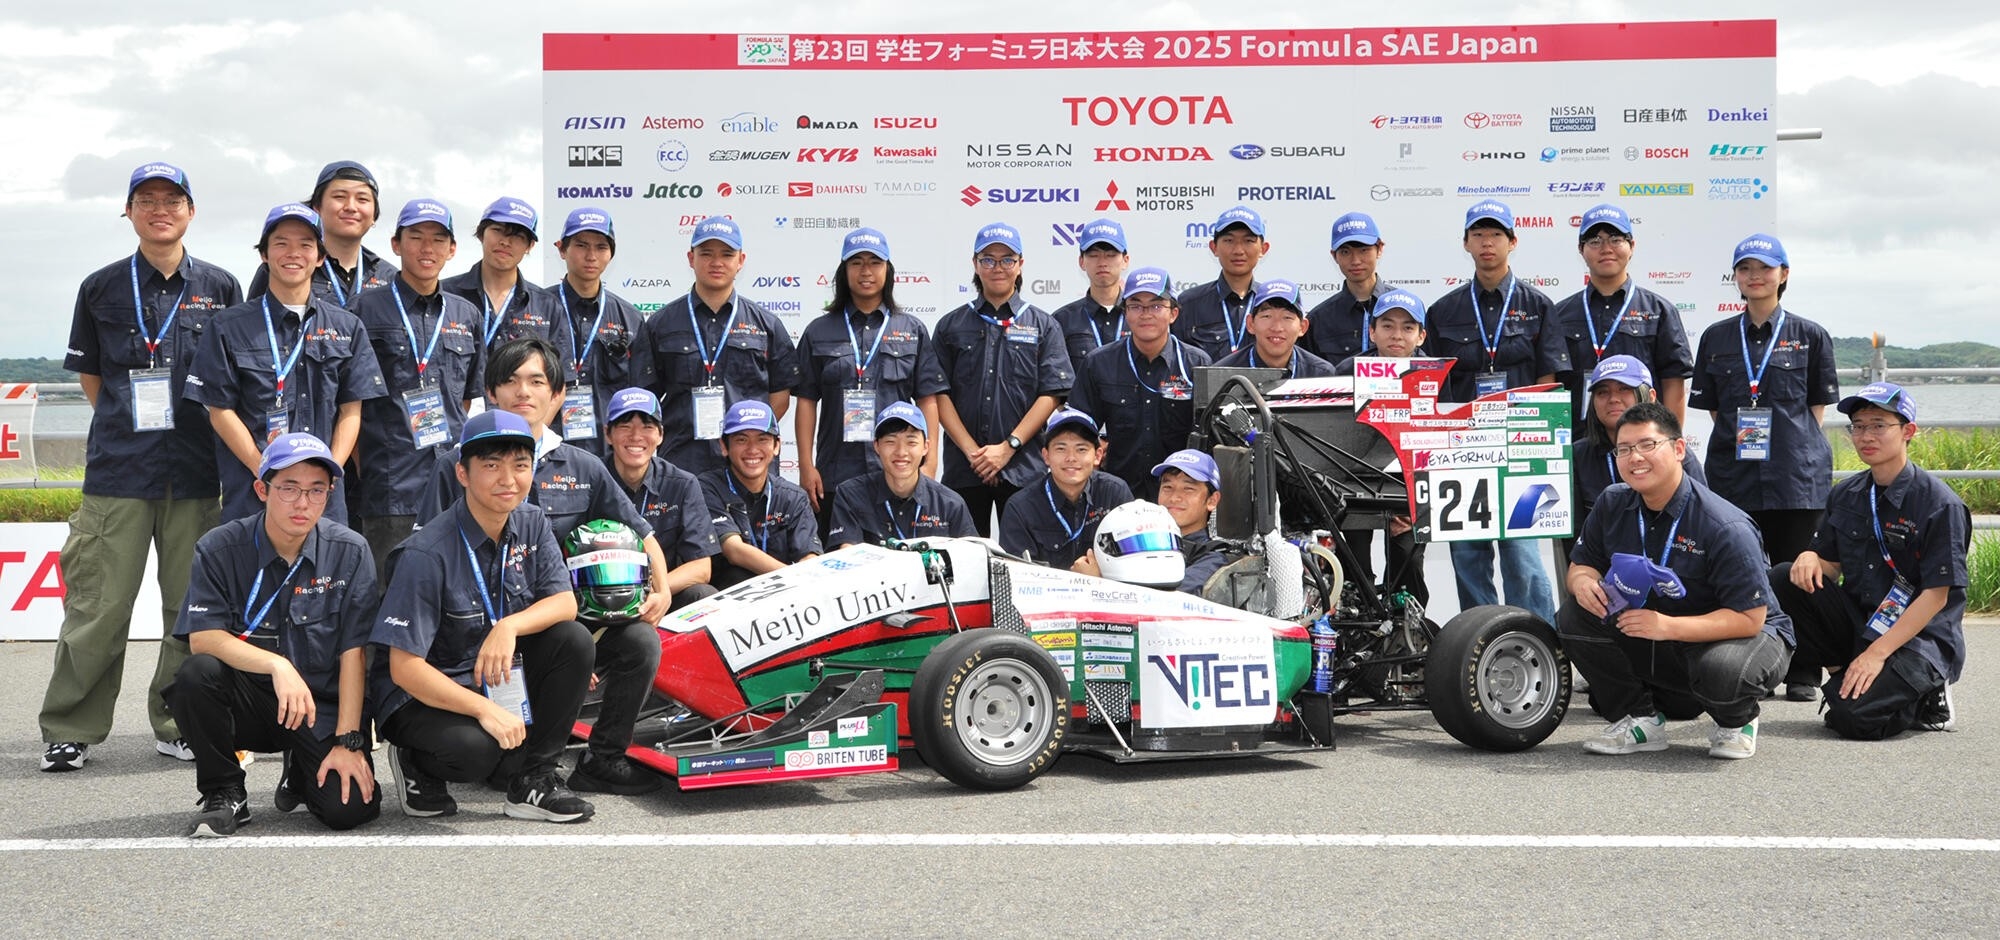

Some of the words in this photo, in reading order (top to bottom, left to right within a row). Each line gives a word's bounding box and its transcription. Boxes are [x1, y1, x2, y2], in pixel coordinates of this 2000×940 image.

[793, 38, 869, 62] 第23回
[876, 35, 1145, 62] 学生フォーミュラ日本大会
[1154, 36, 1232, 59] 2025
[1240, 33, 1372, 58] Formula
[1382, 32, 1439, 56] SAE
[1446, 32, 1538, 60] Japan
[1062, 95, 1233, 126] TOYOTA
[1551, 106, 1594, 116] NISSAN
[1624, 108, 1687, 123] 日産車体
[1708, 108, 1768, 122] Denkei
[564, 116, 626, 130] AISIN
[641, 115, 704, 130] Astemo
[721, 117, 778, 133] enable
[796, 115, 859, 130] AMADA
[874, 117, 937, 129] ISUZU
[1390, 116, 1443, 124] トヨタ車体
[874, 146, 937, 157] Kawasaki
[967, 143, 1073, 156] NISSAN
[1094, 147, 1214, 162] HONDA
[1271, 146, 1346, 157] SUBARU
[1645, 148, 1689, 158] BOSCH
[568, 145, 622, 167] HKS
[740, 151, 791, 160] MUGEN
[796, 148, 859, 163] KYB
[1480, 151, 1526, 160] HINO
[1004, 160, 1072, 168] CORPORATION
[558, 184, 633, 199] KOMATSU
[643, 182, 703, 199] Jatco
[735, 185, 780, 195] SOLIZE
[816, 184, 867, 194] DAIHATSU
[874, 182, 937, 192] TAMADIC
[1136, 186, 1215, 197] MITSUBISHI
[1457, 185, 1531, 194] MinebeaMitsumi
[1624, 185, 1689, 195] YANASE
[1708, 185, 1751, 194] AUTO
[988, 188, 1080, 203] SUZUKI
[1238, 186, 1336, 201] PROTERIAL
[1136, 200, 1194, 211] MOTORS
[679, 215, 733, 226] DENO
[631, 279, 671, 288] AZAPA
[1031, 279, 1061, 295] GLM
[192, 296, 213, 304] Meijo
[1357, 362, 1398, 378] NSK
[1393, 409, 1410, 418] FRP
[1466, 435, 1487, 443] SAKAI
[1452, 450, 1507, 464] FORMULA
[553, 475, 576, 483] Meijo
[541, 482, 568, 491] Racing
[570, 482, 591, 490] Team
[1416, 480, 1429, 504] C
[648, 502, 667, 510] Meijo
[1438, 478, 1492, 532] 24
[1539, 511, 1568, 520] DAIWA
[1539, 520, 1565, 528] KASEI
[1091, 590, 1138, 600] RevCraft
[727, 603, 821, 656] Meijo
[834, 581, 916, 623] Univ.
[817, 751, 856, 765] BRITEN
[858, 749, 885, 762] TUBE
